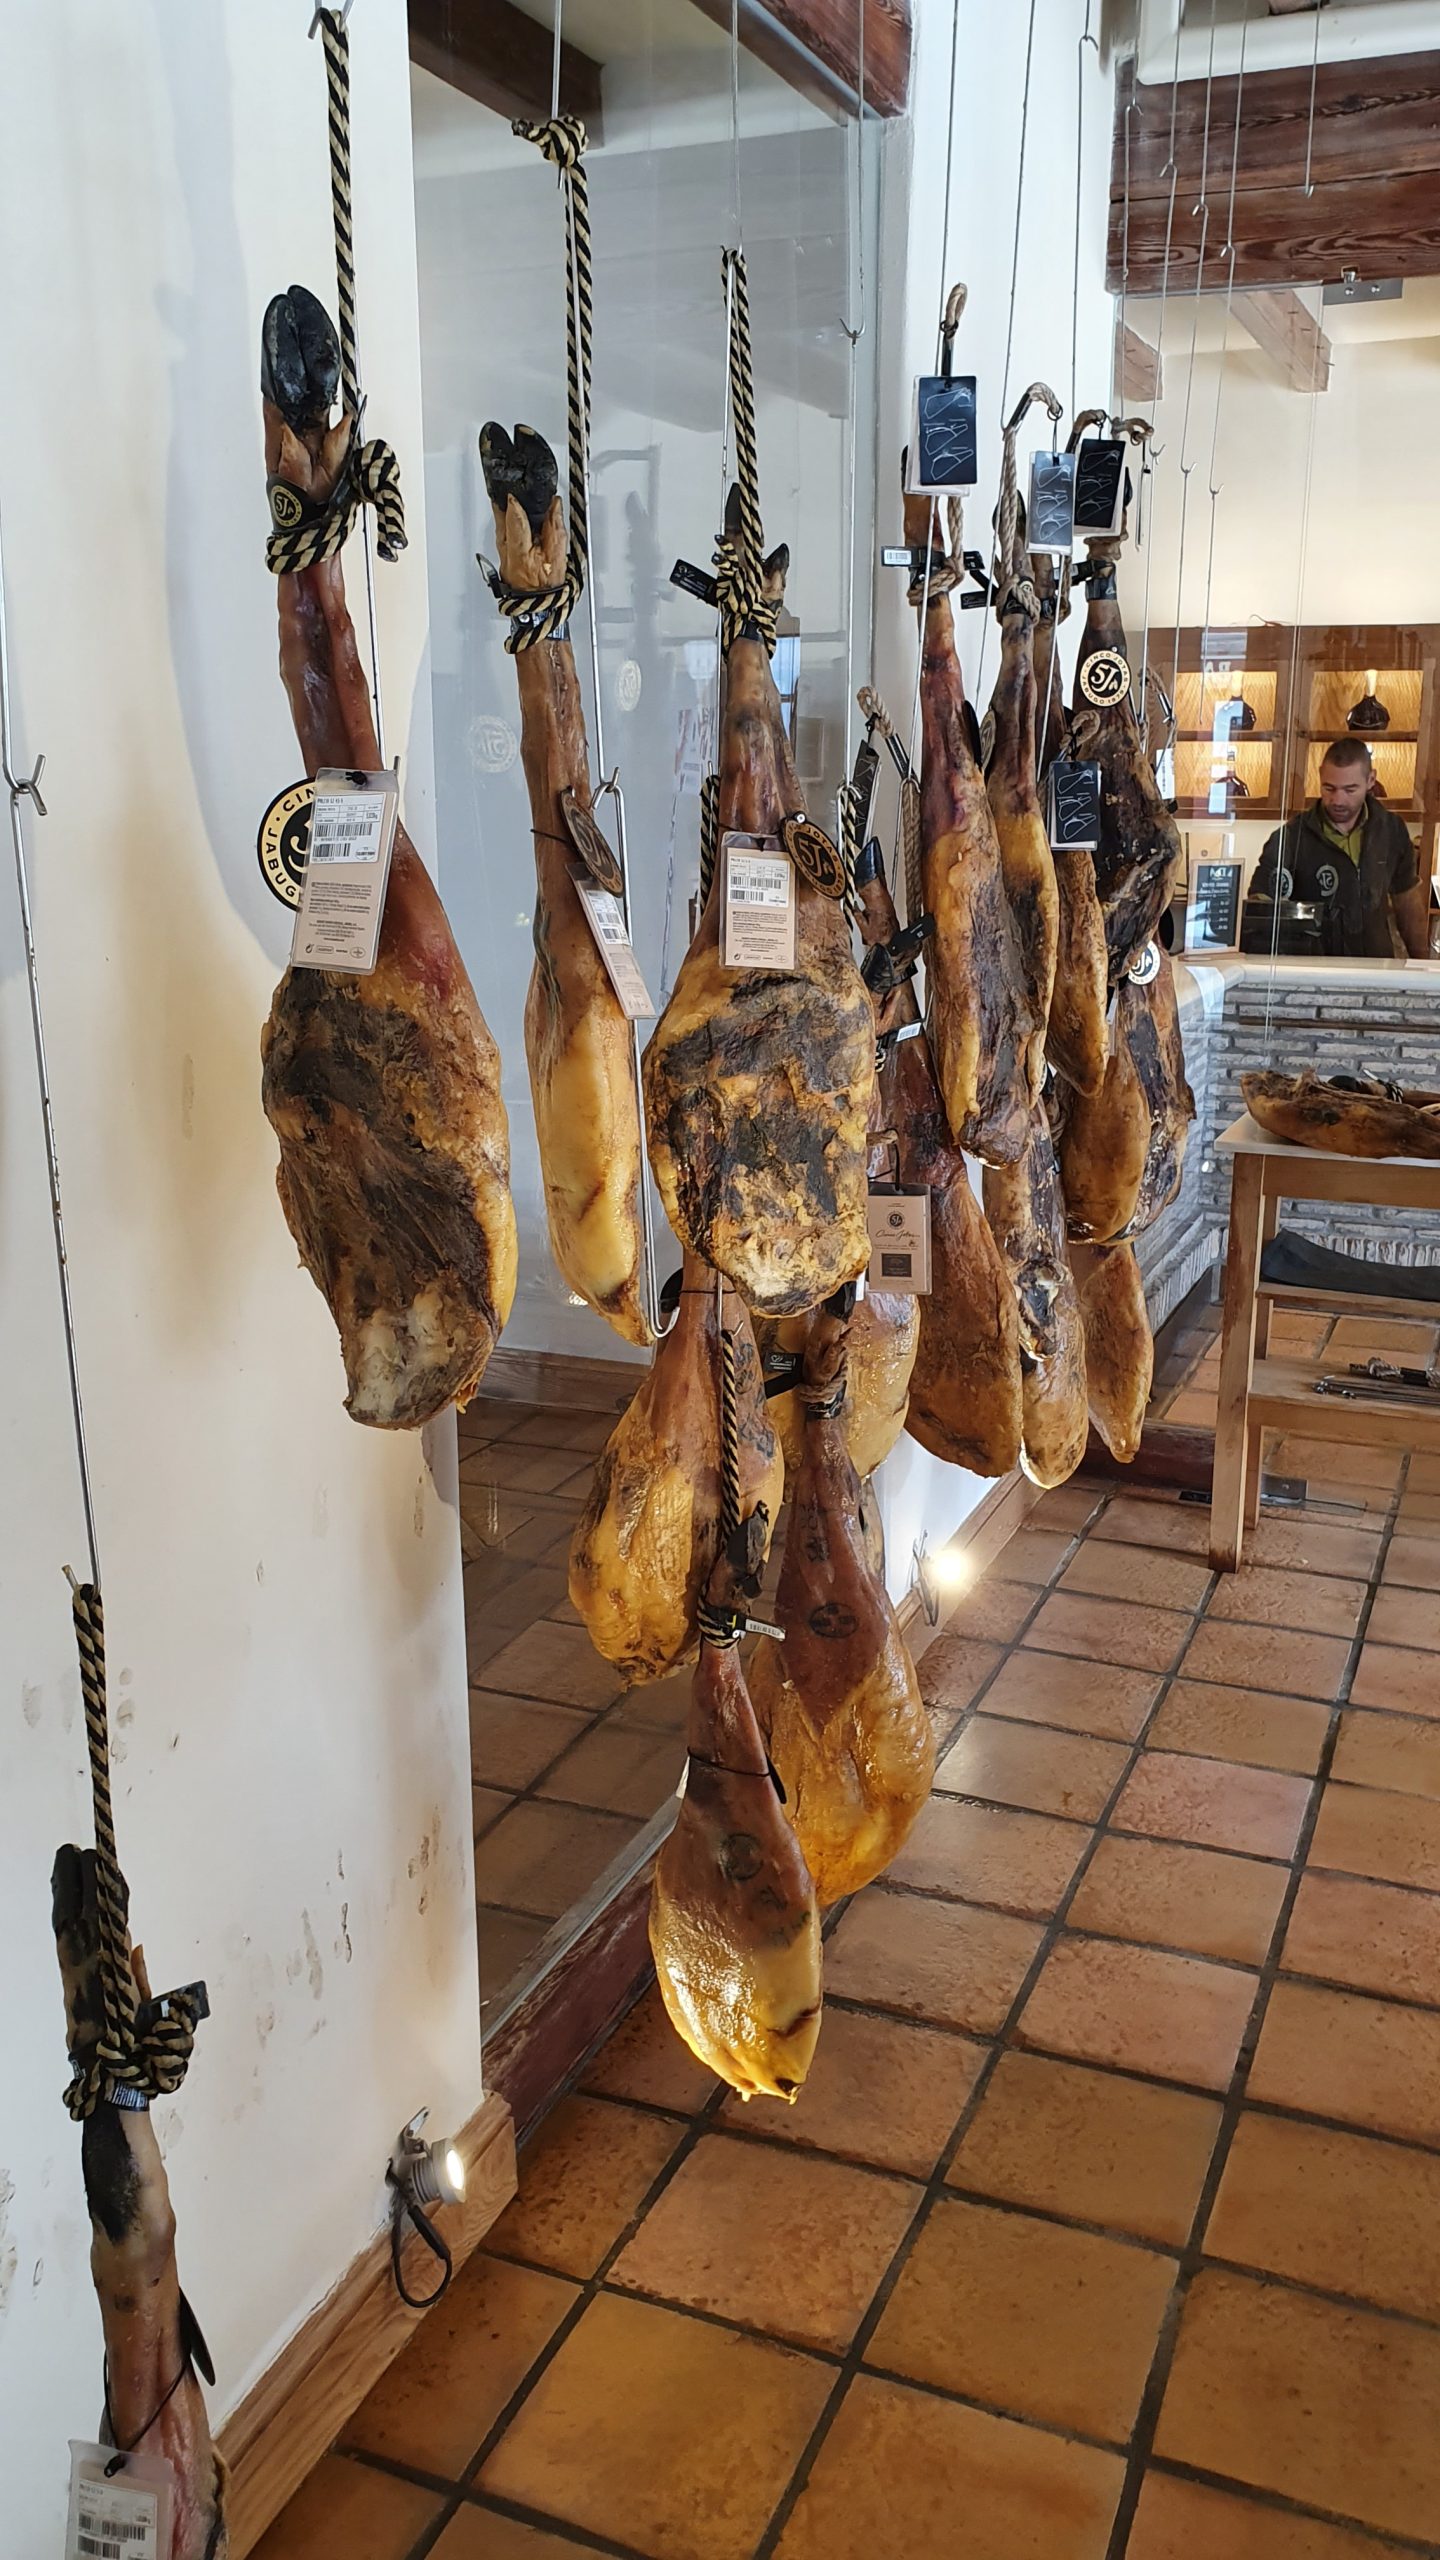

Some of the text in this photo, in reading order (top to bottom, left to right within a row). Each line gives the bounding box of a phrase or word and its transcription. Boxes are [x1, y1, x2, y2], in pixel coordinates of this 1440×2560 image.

[276, 495, 289, 517] 5J
[1086, 652, 1129, 682] CINCO JOTAS
[1090, 663, 1119, 692] 5J
[265, 827, 297, 898] JABUG
